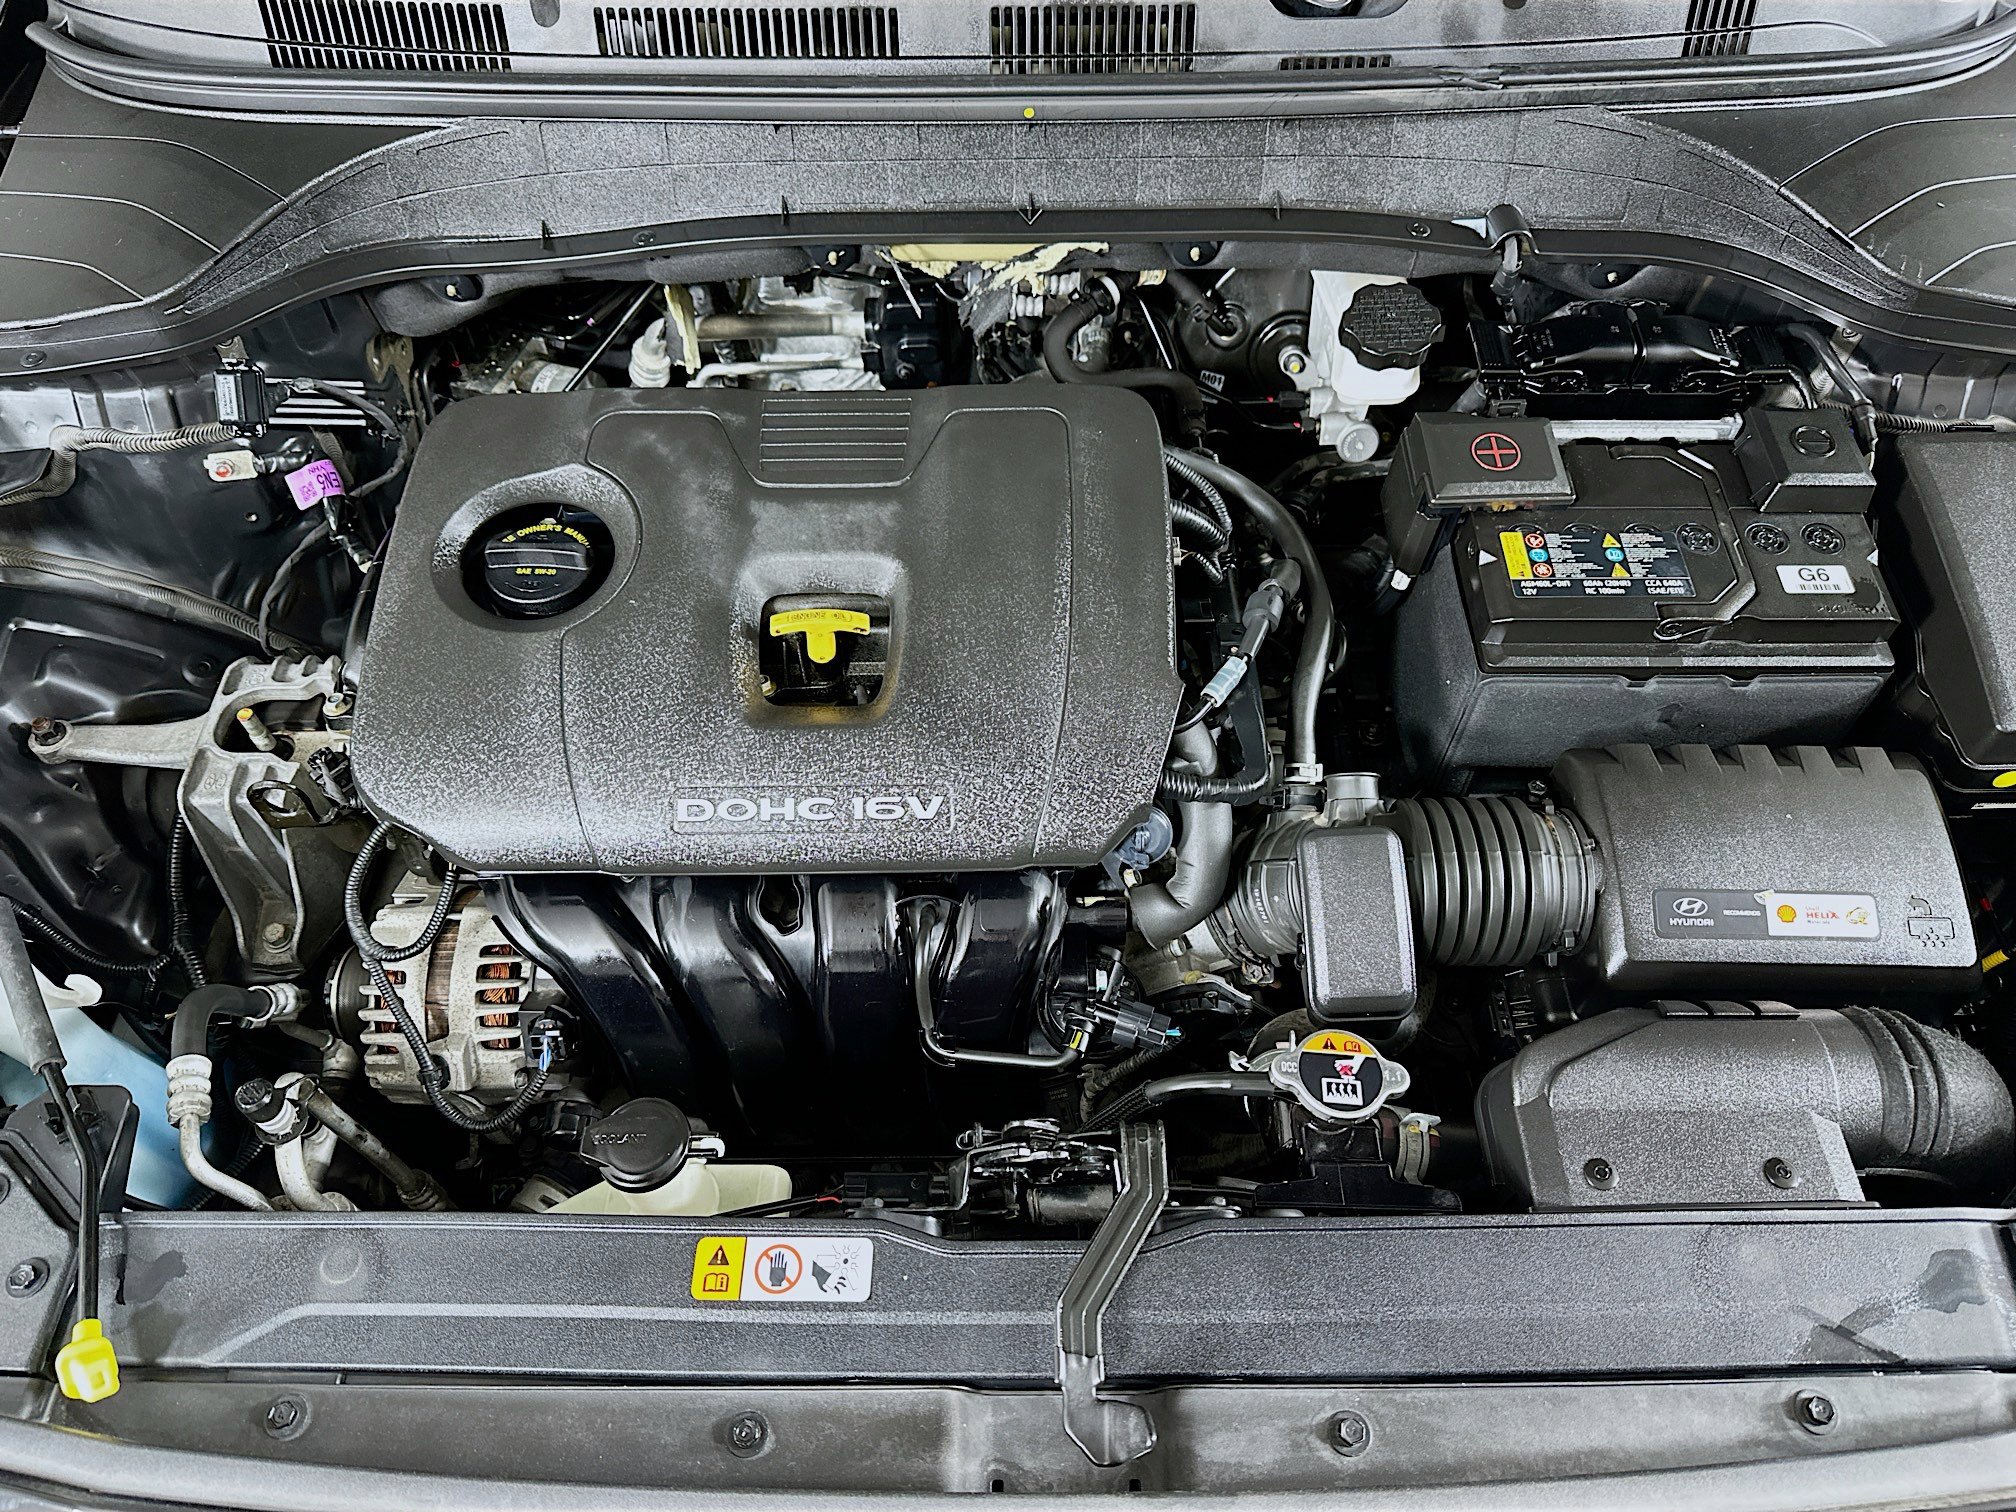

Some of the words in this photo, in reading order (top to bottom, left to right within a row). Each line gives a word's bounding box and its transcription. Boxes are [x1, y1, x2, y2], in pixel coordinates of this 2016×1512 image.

[516, 524, 563, 538] OWNER'S
[515, 567, 532, 575] SAE
[1798, 567, 1830, 582] G6
[1583, 580, 1604, 588] 60Ah
[677, 796, 836, 822] DOHC
[852, 794, 944, 820] 16V
[1806, 910, 1840, 919] HELIX
[1669, 917, 1715, 927] HYUNDAI
[592, 1133, 647, 1145] COOLANT
